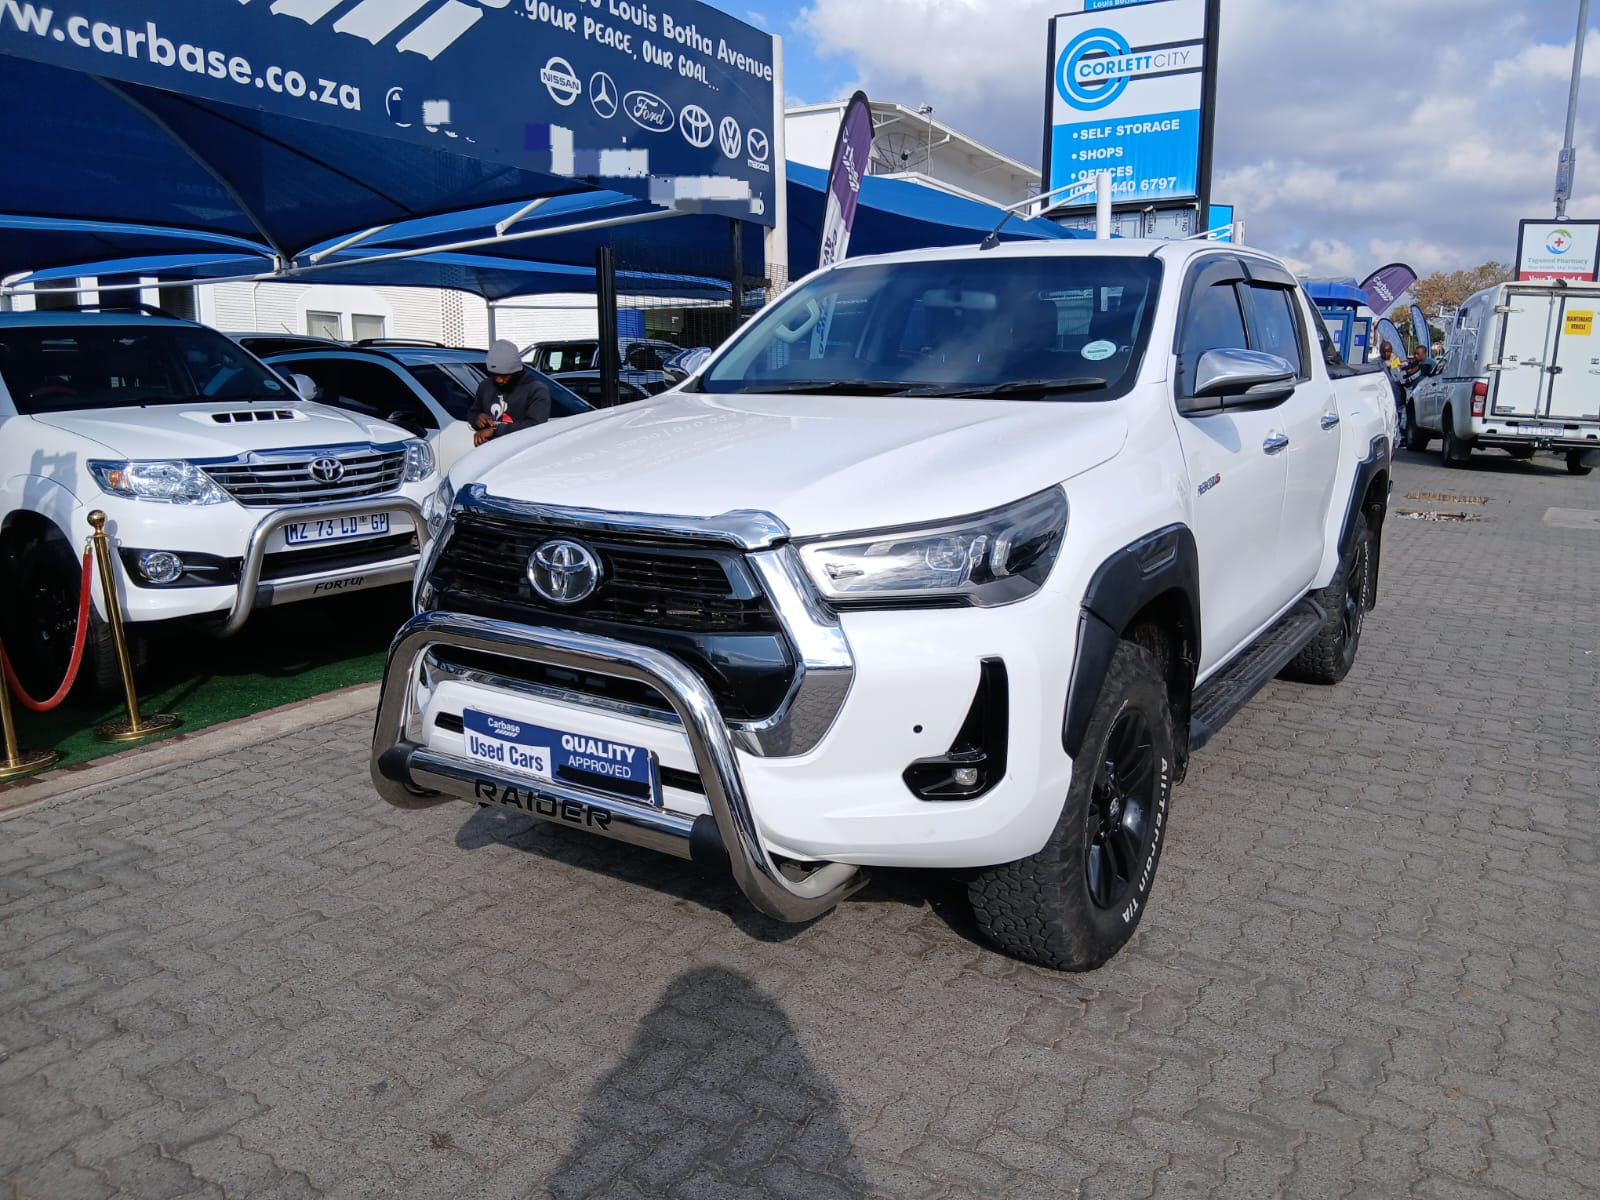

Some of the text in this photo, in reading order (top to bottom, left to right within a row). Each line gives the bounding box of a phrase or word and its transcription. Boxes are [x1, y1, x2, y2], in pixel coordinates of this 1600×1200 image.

[583, 16, 637, 60] PEACE,
[642, 40, 673, 70] OUR
[609, 0, 772, 81] Louis Botha Avenue
[1080, 50, 1190, 77] CORLETT CITY
[543, 71, 579, 91] NISSAN
[633, 96, 666, 125] Ford
[1080, 119, 1180, 140] SELF STORAGE
[1079, 147, 1124, 160] SHOPS
[1141, 177, 1177, 190] 6797
[289, 523, 308, 540] MZ
[317, 520, 334, 537] 73
[371, 513, 386, 530] GP
[487, 717, 521, 733] Carbase
[470, 735, 544, 772] Used Cars
[561, 734, 636, 763] QUALITY
[568, 755, 631, 778] APPROVED
[474, 780, 613, 831] RAIDER
[1121, 757, 1168, 922] All-Terrain T/A
